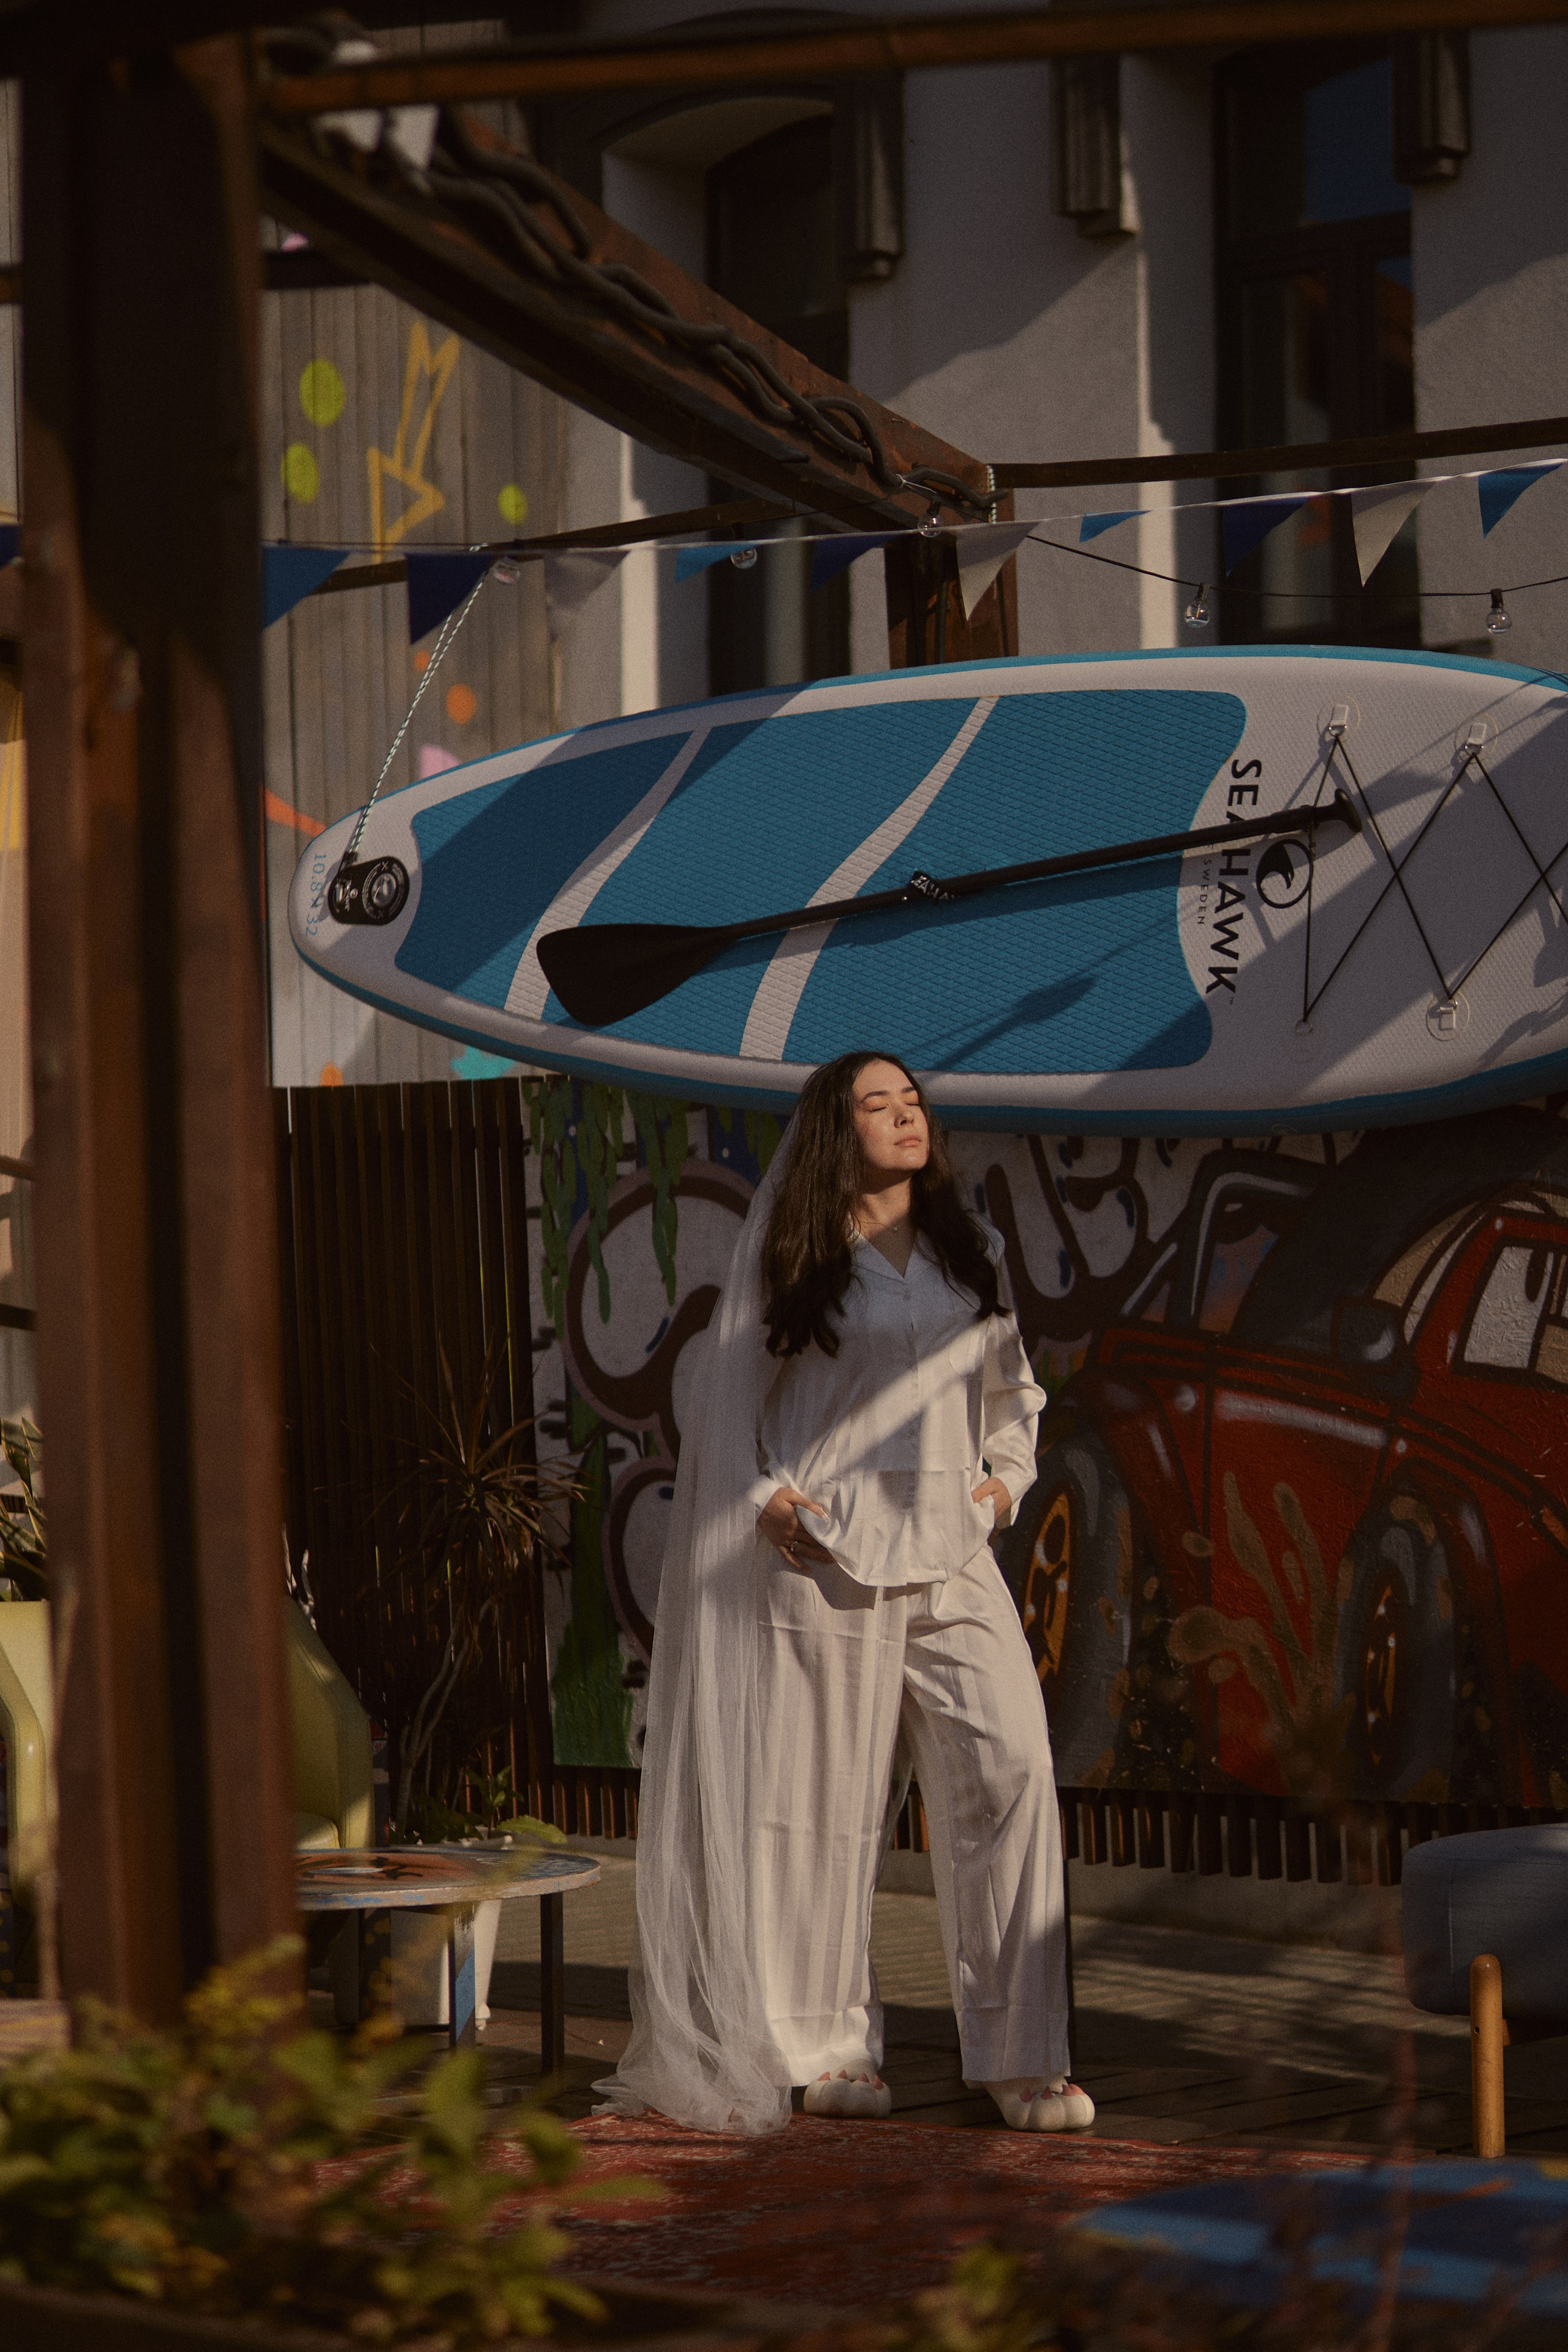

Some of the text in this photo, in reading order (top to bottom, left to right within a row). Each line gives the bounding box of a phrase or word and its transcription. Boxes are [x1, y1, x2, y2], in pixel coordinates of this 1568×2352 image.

[311, 853, 326, 891] 10.8
[1197, 859, 1212, 924] SWEDEN
[306, 914, 318, 937] 32
